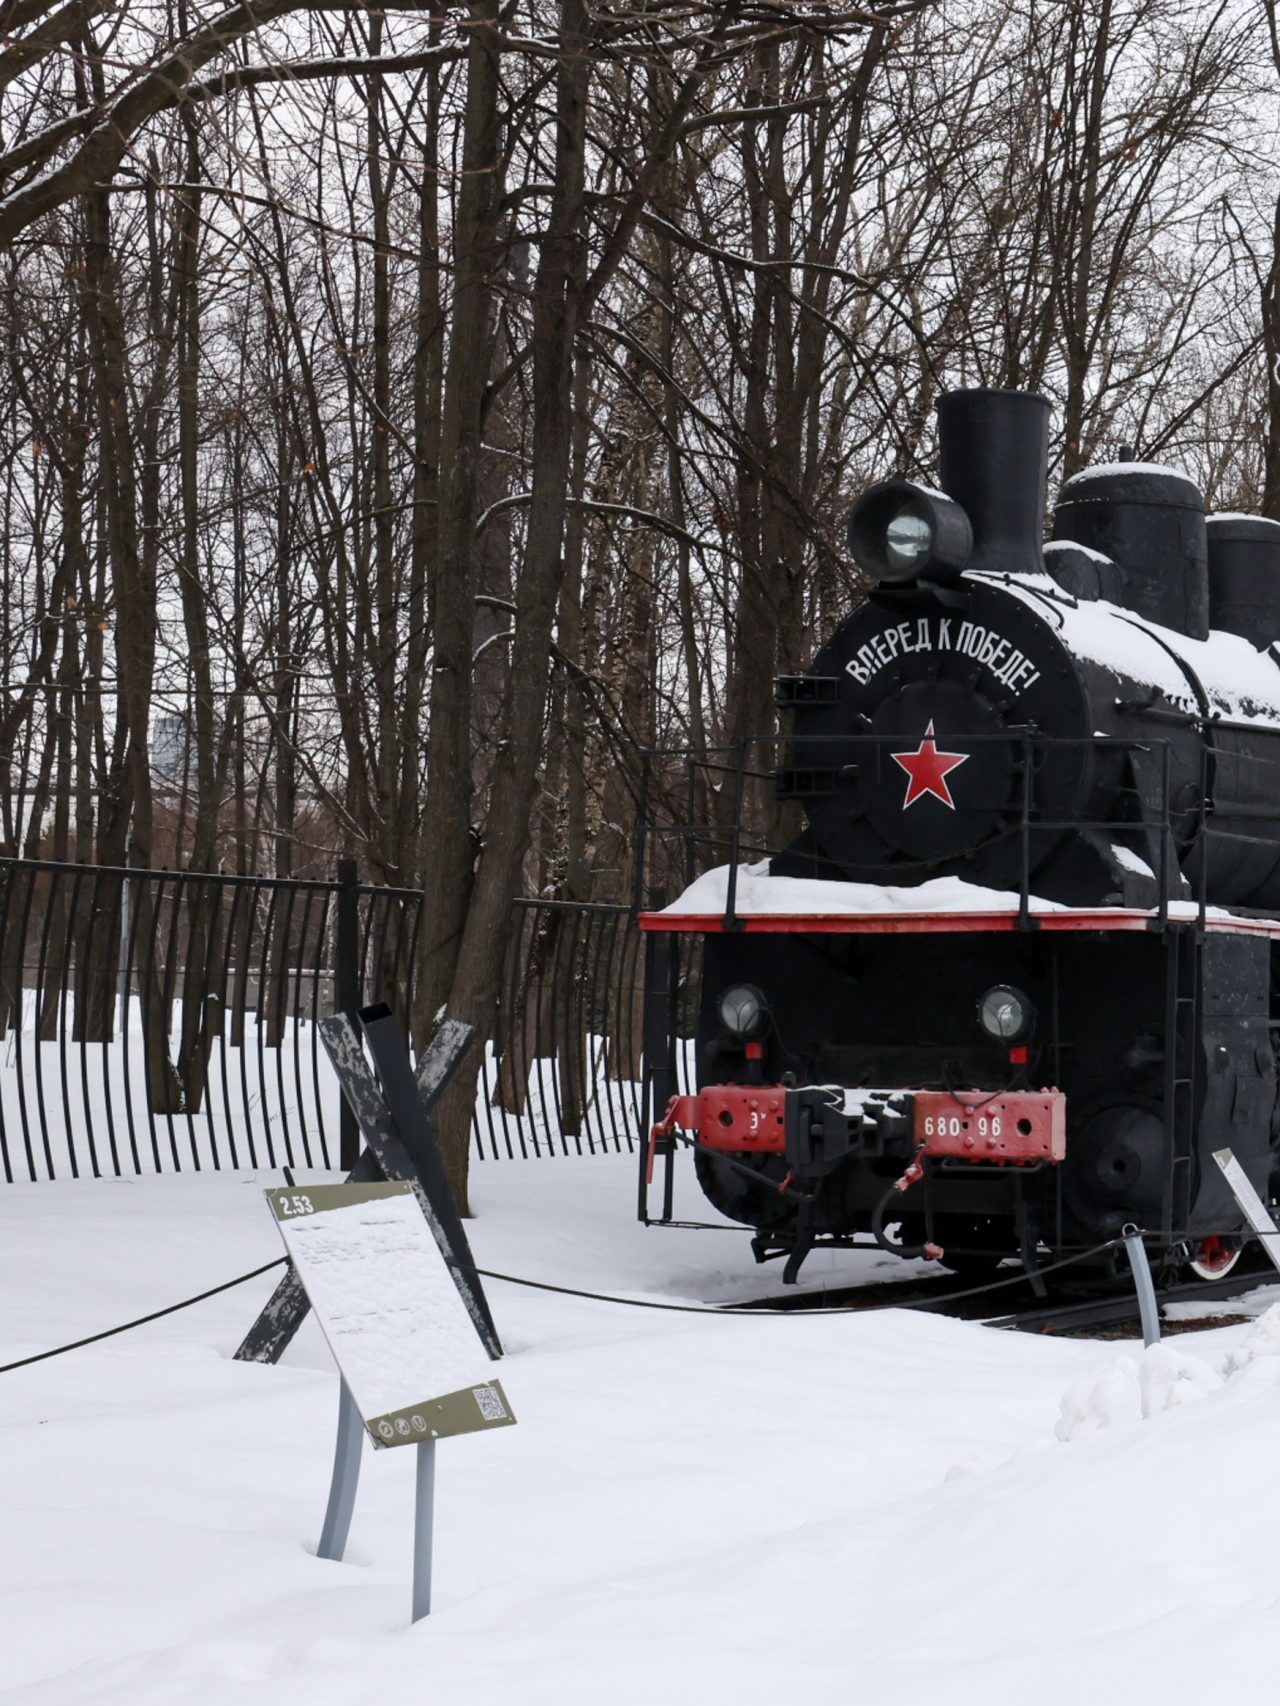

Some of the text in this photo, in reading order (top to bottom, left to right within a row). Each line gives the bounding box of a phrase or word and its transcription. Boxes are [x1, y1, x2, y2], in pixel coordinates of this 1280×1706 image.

[845, 617, 1041, 696] ВПЕРЕД К ПОБЕДЕ!
[924, 1116, 960, 1136] 680
[978, 1117, 1001, 1136] 96
[279, 1195, 314, 1215] 2.53
